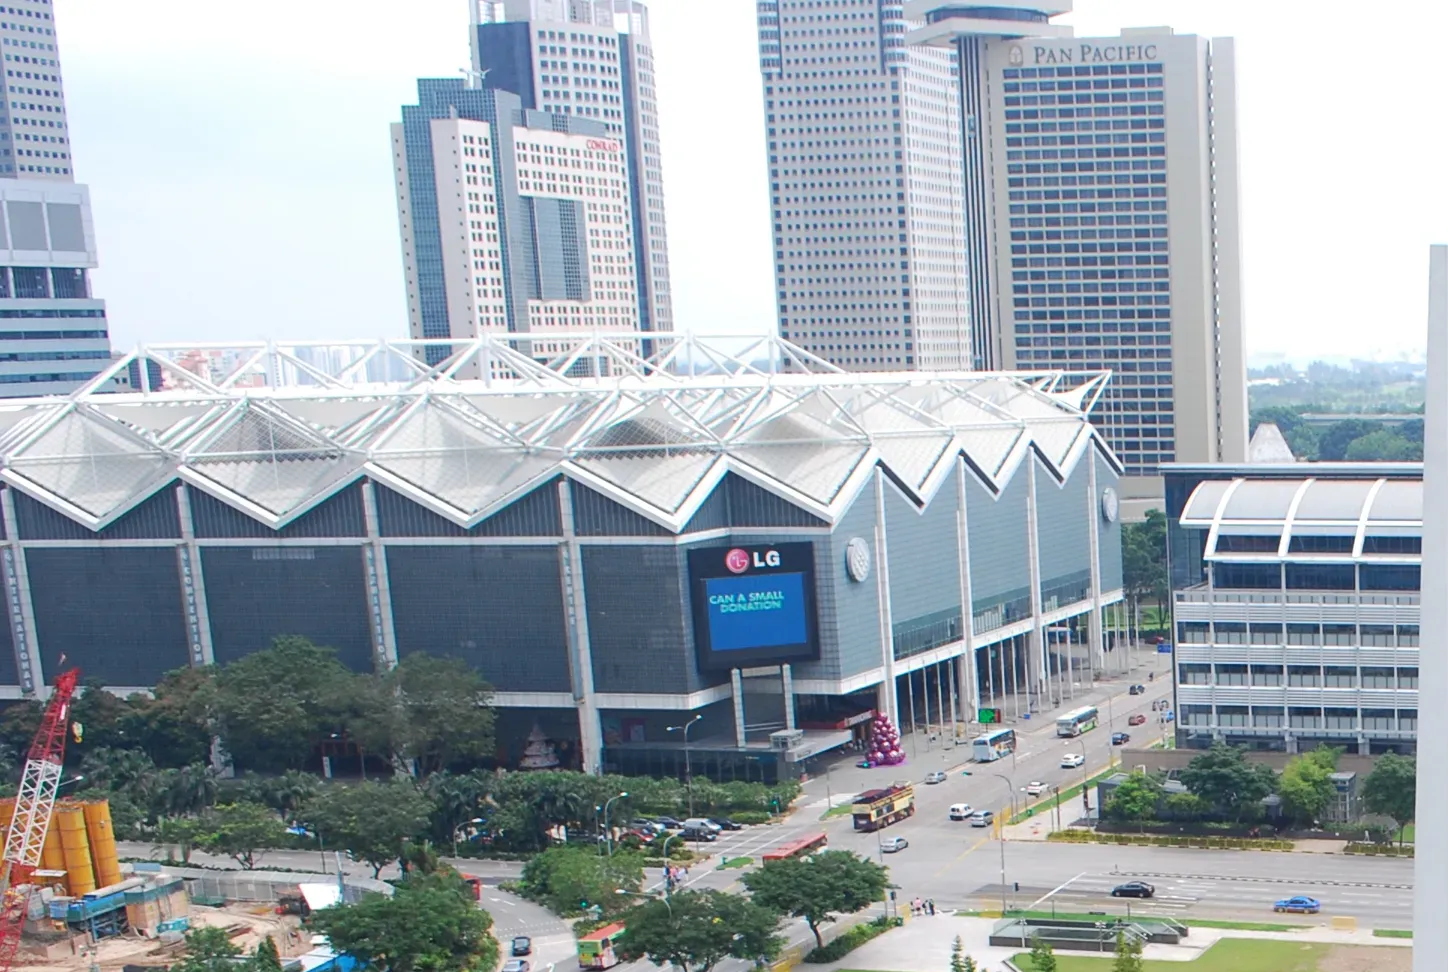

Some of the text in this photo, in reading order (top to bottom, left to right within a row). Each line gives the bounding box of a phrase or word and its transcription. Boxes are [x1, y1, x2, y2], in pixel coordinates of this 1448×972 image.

[1034, 44, 1158, 64] PAN PACIFIC
[752, 550, 781, 568] LG
[709, 590, 785, 605] CAN A SMALL
[720, 600, 781, 613] DONATION
[183, 566, 203, 662] CONVENTION
[8, 567, 32, 689] INTERNATIONAL
